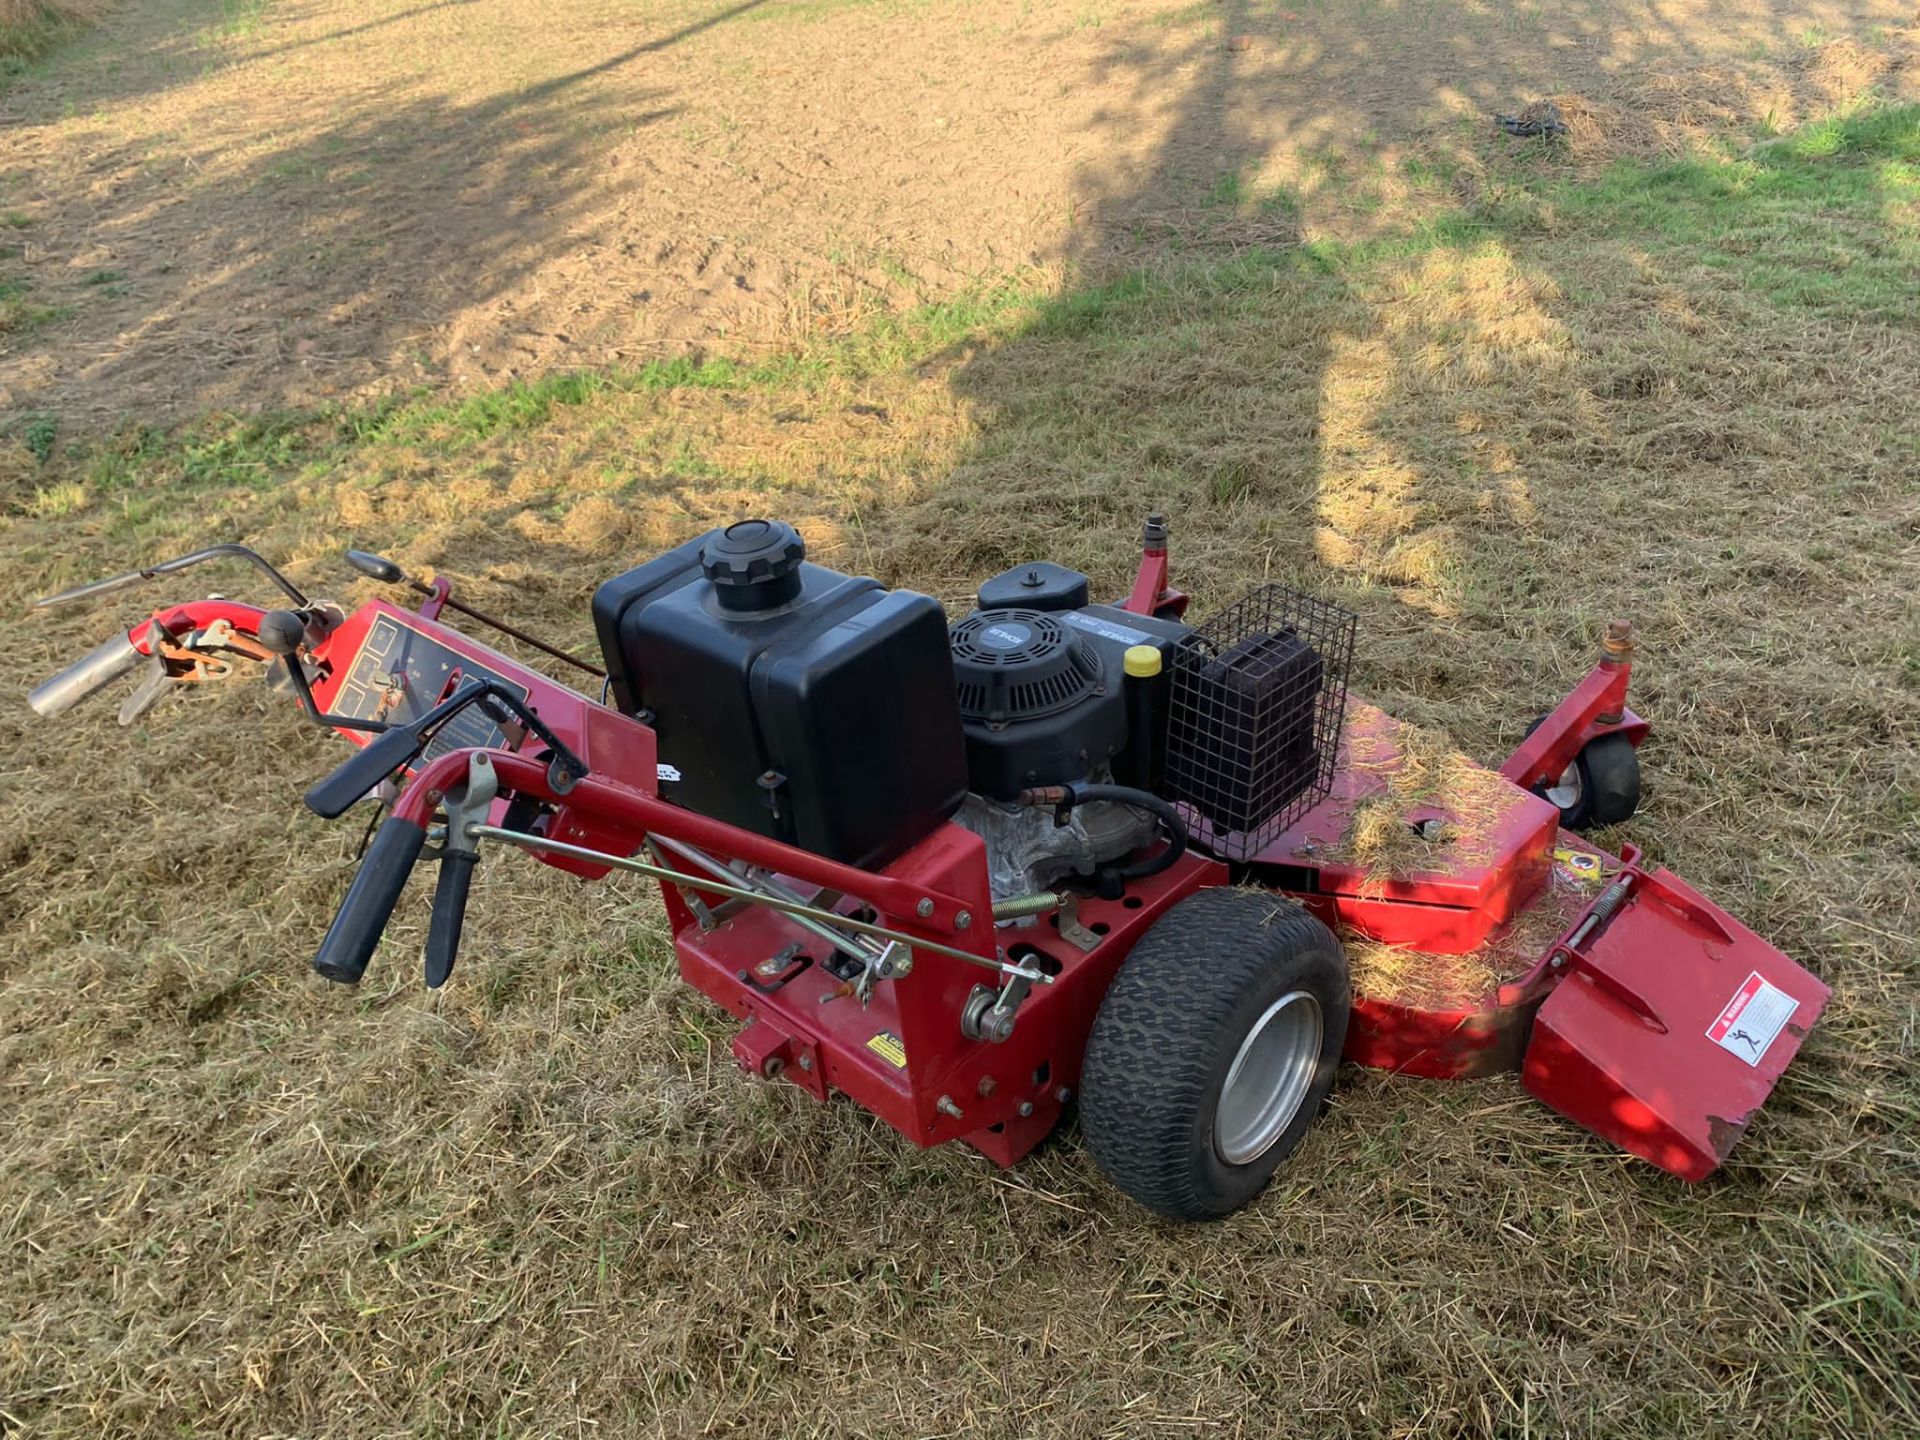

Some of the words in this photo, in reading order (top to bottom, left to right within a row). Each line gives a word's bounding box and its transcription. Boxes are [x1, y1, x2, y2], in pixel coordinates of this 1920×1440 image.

[989, 627, 1023, 643] KOHLER
[1098, 630, 1137, 645] KOHLER
[1726, 991, 1749, 1019] WARNING
